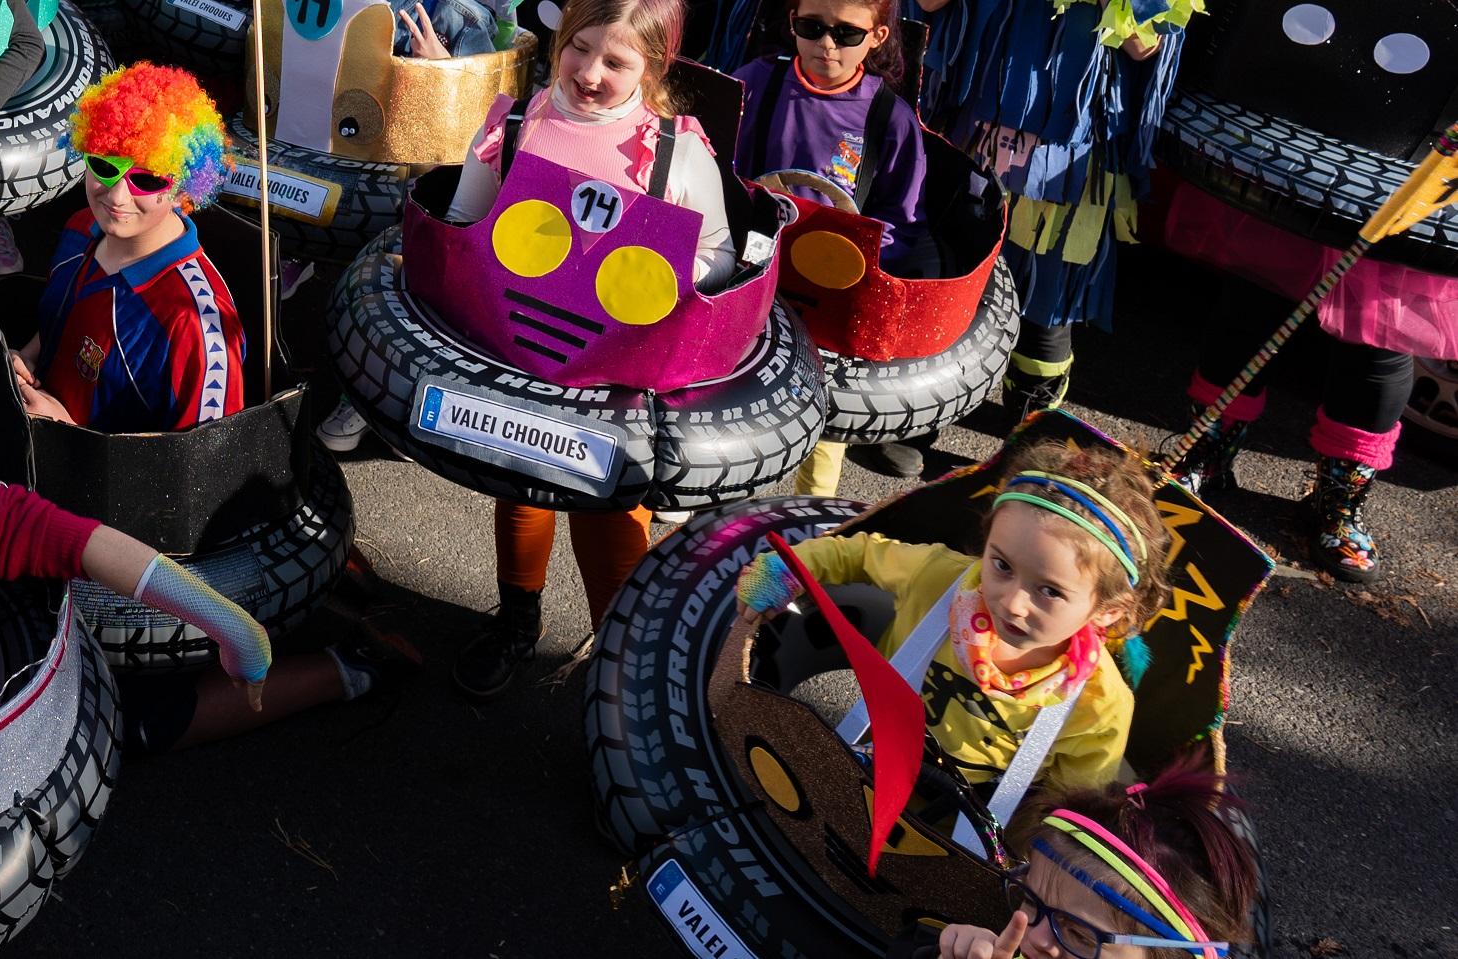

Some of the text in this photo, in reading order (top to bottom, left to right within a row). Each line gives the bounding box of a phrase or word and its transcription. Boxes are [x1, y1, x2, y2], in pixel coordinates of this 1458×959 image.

[199, 2, 233, 22] CHOQUES
[230, 171, 255, 188] VALEI
[578, 186, 619, 229] 14
[450, 405, 498, 435] VALEI
[501, 420, 589, 461] CHOQUES
